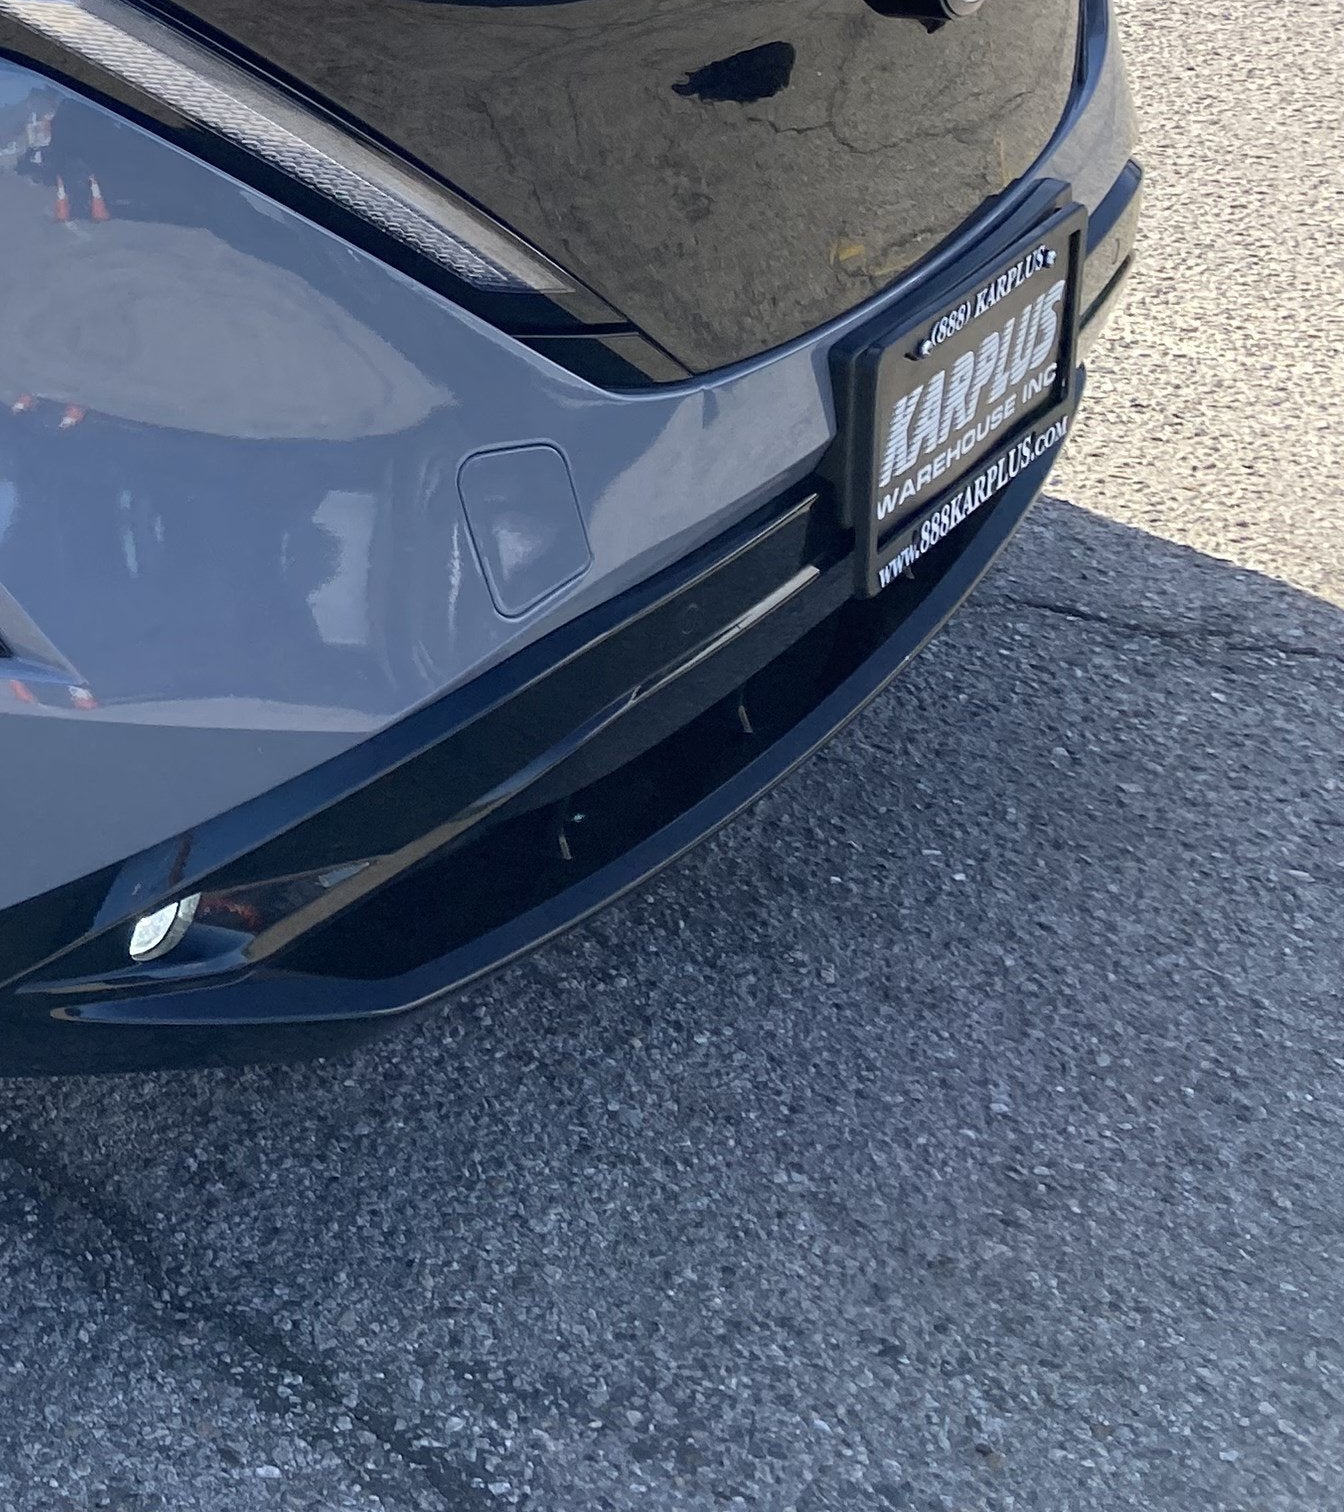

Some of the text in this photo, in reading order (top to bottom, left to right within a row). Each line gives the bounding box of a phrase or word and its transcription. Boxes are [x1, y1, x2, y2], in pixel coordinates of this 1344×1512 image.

[930, 244, 1045, 347] (888) KARPLUS
[878, 279, 1067, 488] KARPLUS
[876, 393, 1018, 521] WAREHOUSE
